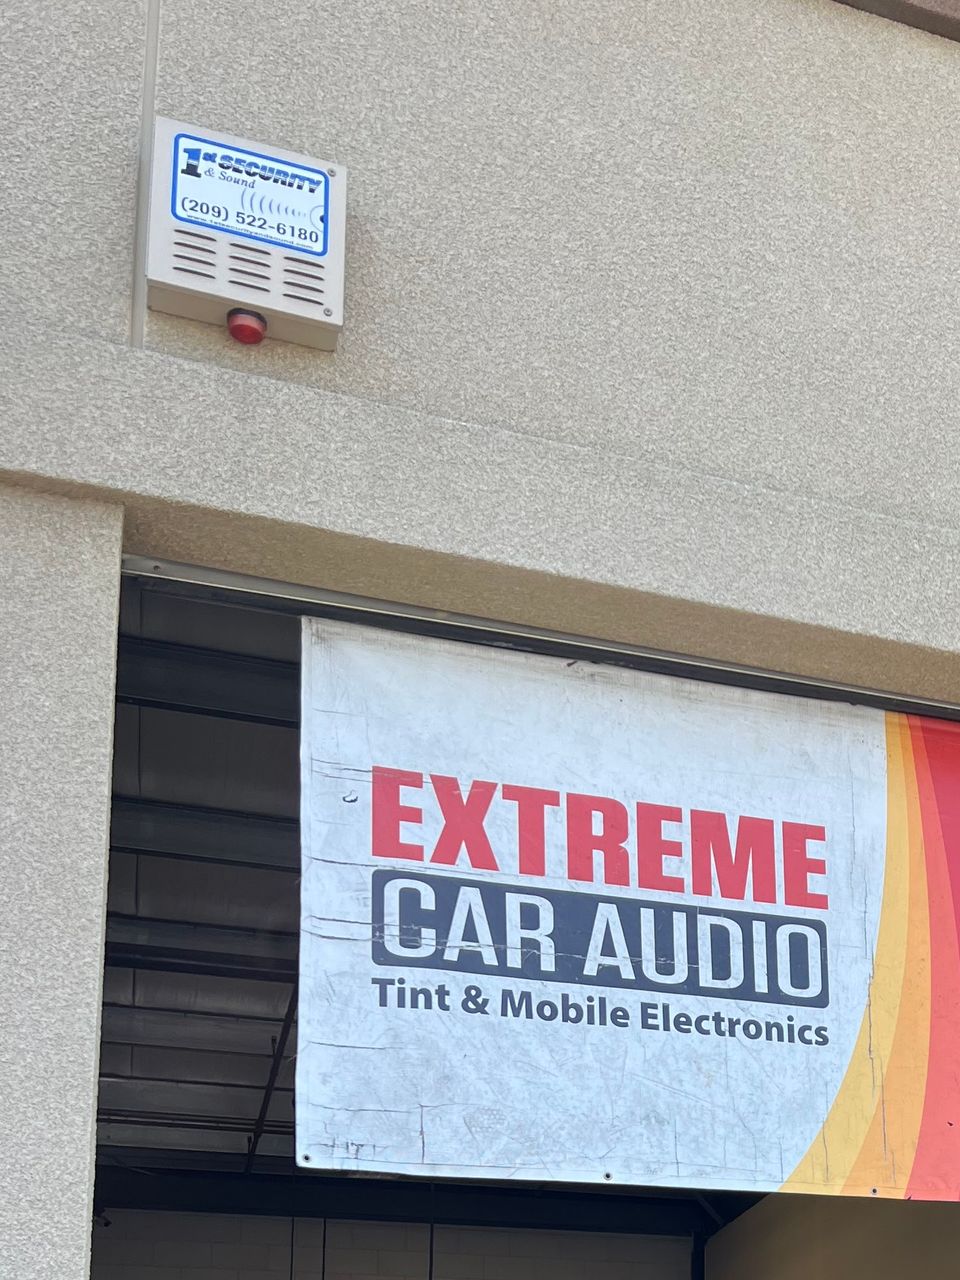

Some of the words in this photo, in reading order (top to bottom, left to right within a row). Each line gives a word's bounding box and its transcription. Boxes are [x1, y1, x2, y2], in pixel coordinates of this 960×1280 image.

[204, 167, 215, 177] &
[218, 171, 256, 188] Sound
[218, 154, 322, 193] SECURITY
[181, 196, 229, 221] (209)
[235, 211, 319, 243] 522-6180
[371, 765, 829, 910] EXTREME
[382, 877, 556, 973] CAR
[582, 902, 823, 999] AUDIO
[371, 977, 451, 1012] Tint
[461, 984, 490, 1015] &
[499, 988, 630, 1028] Mobile
[640, 1002, 830, 1046] Electronics
